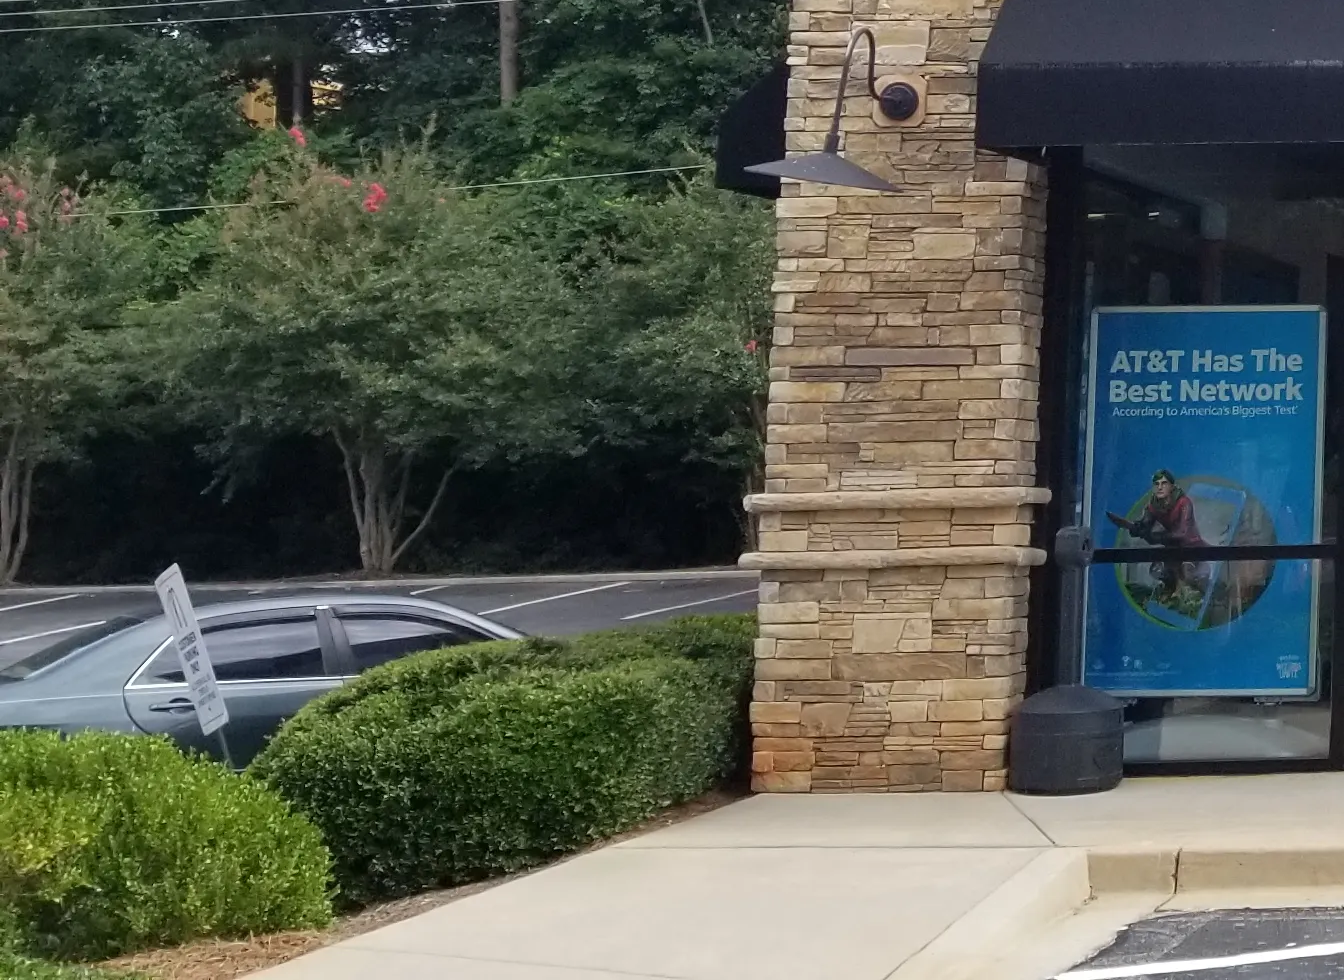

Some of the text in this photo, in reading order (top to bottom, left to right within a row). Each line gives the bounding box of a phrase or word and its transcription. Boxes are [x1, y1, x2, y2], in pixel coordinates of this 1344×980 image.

[1108, 347, 1304, 374] AT&T Has The
[1109, 376, 1304, 403] Best Network
[1112, 406, 1164, 419] According
[1166, 406, 1178, 416] to
[1180, 405, 1230, 417] America's
[1232, 404, 1271, 418] Biggest
